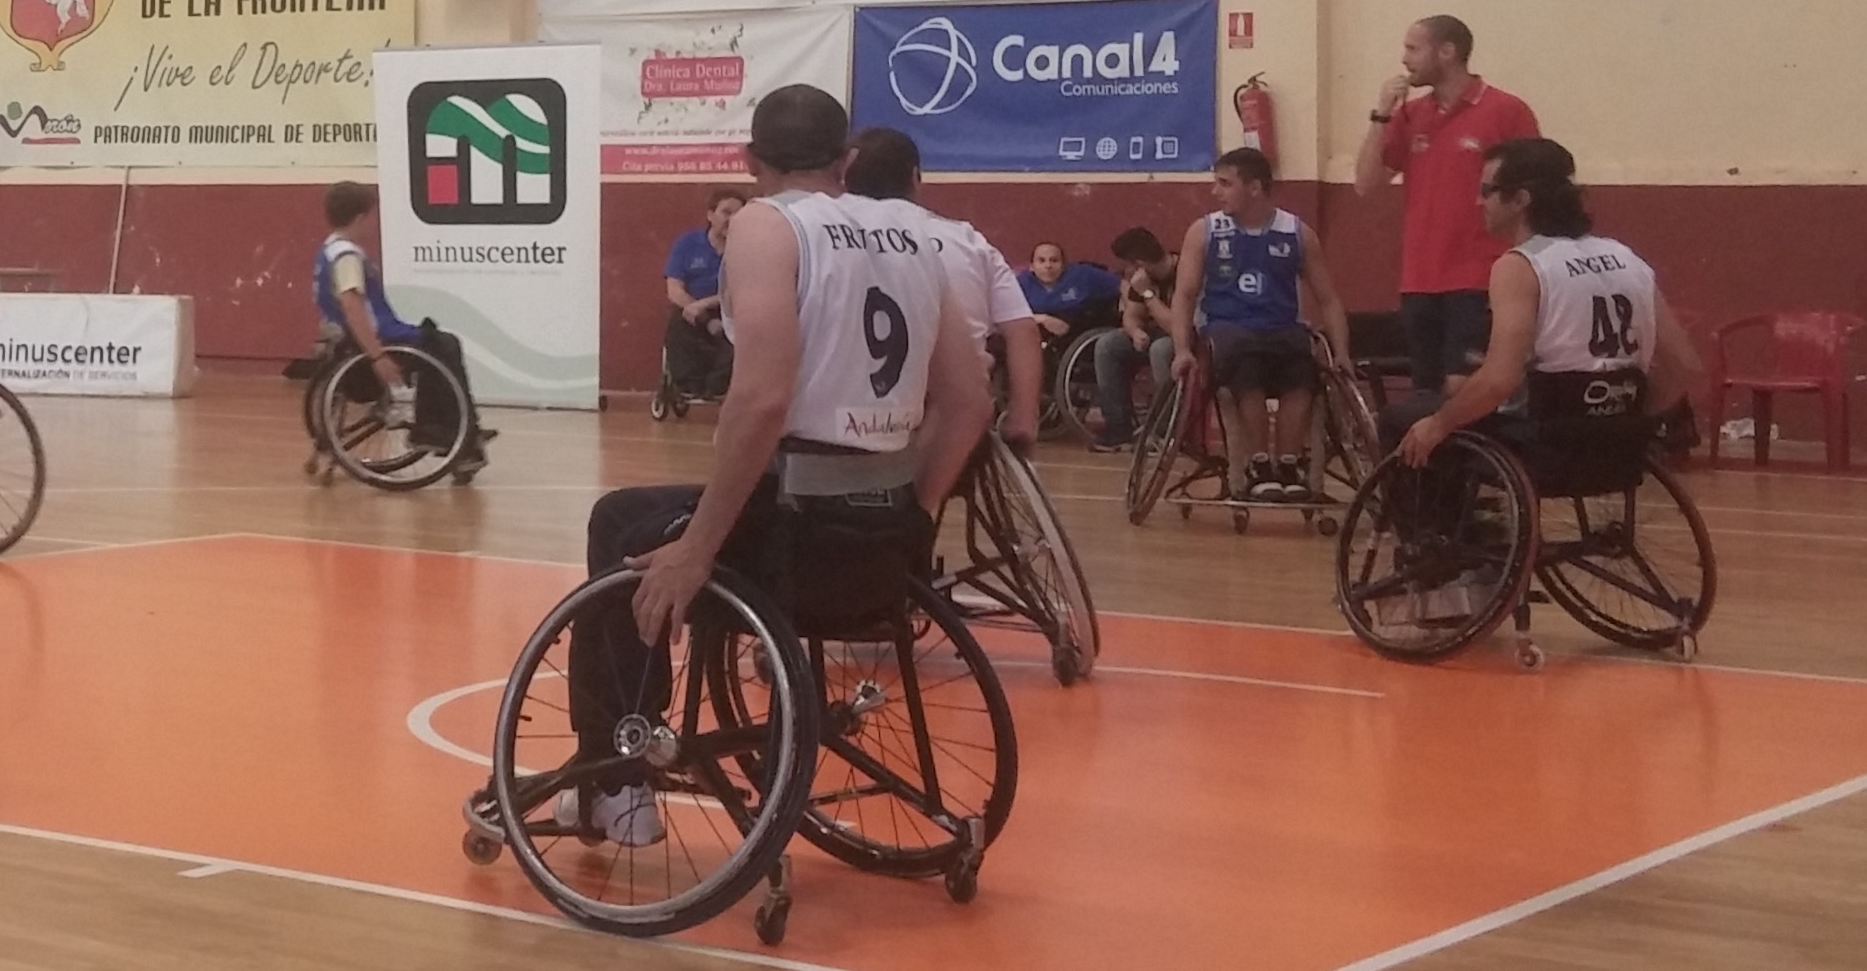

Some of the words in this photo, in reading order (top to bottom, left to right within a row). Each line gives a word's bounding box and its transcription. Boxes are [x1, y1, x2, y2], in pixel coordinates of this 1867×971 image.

[209, 43, 247, 87] el
[993, 31, 1180, 82] Canal4
[695, 63, 740, 77] Dental
[669, 80, 701, 91] Laura
[1060, 80, 1179, 97] Comunicaciones
[94, 124, 180, 144] PATRONATO
[188, 124, 275, 144] MUNICIPAL
[284, 124, 304, 144] DE
[312, 123, 377, 143] DEPORT
[413, 239, 567, 264] minuscenter
[863, 286, 909, 400] 9
